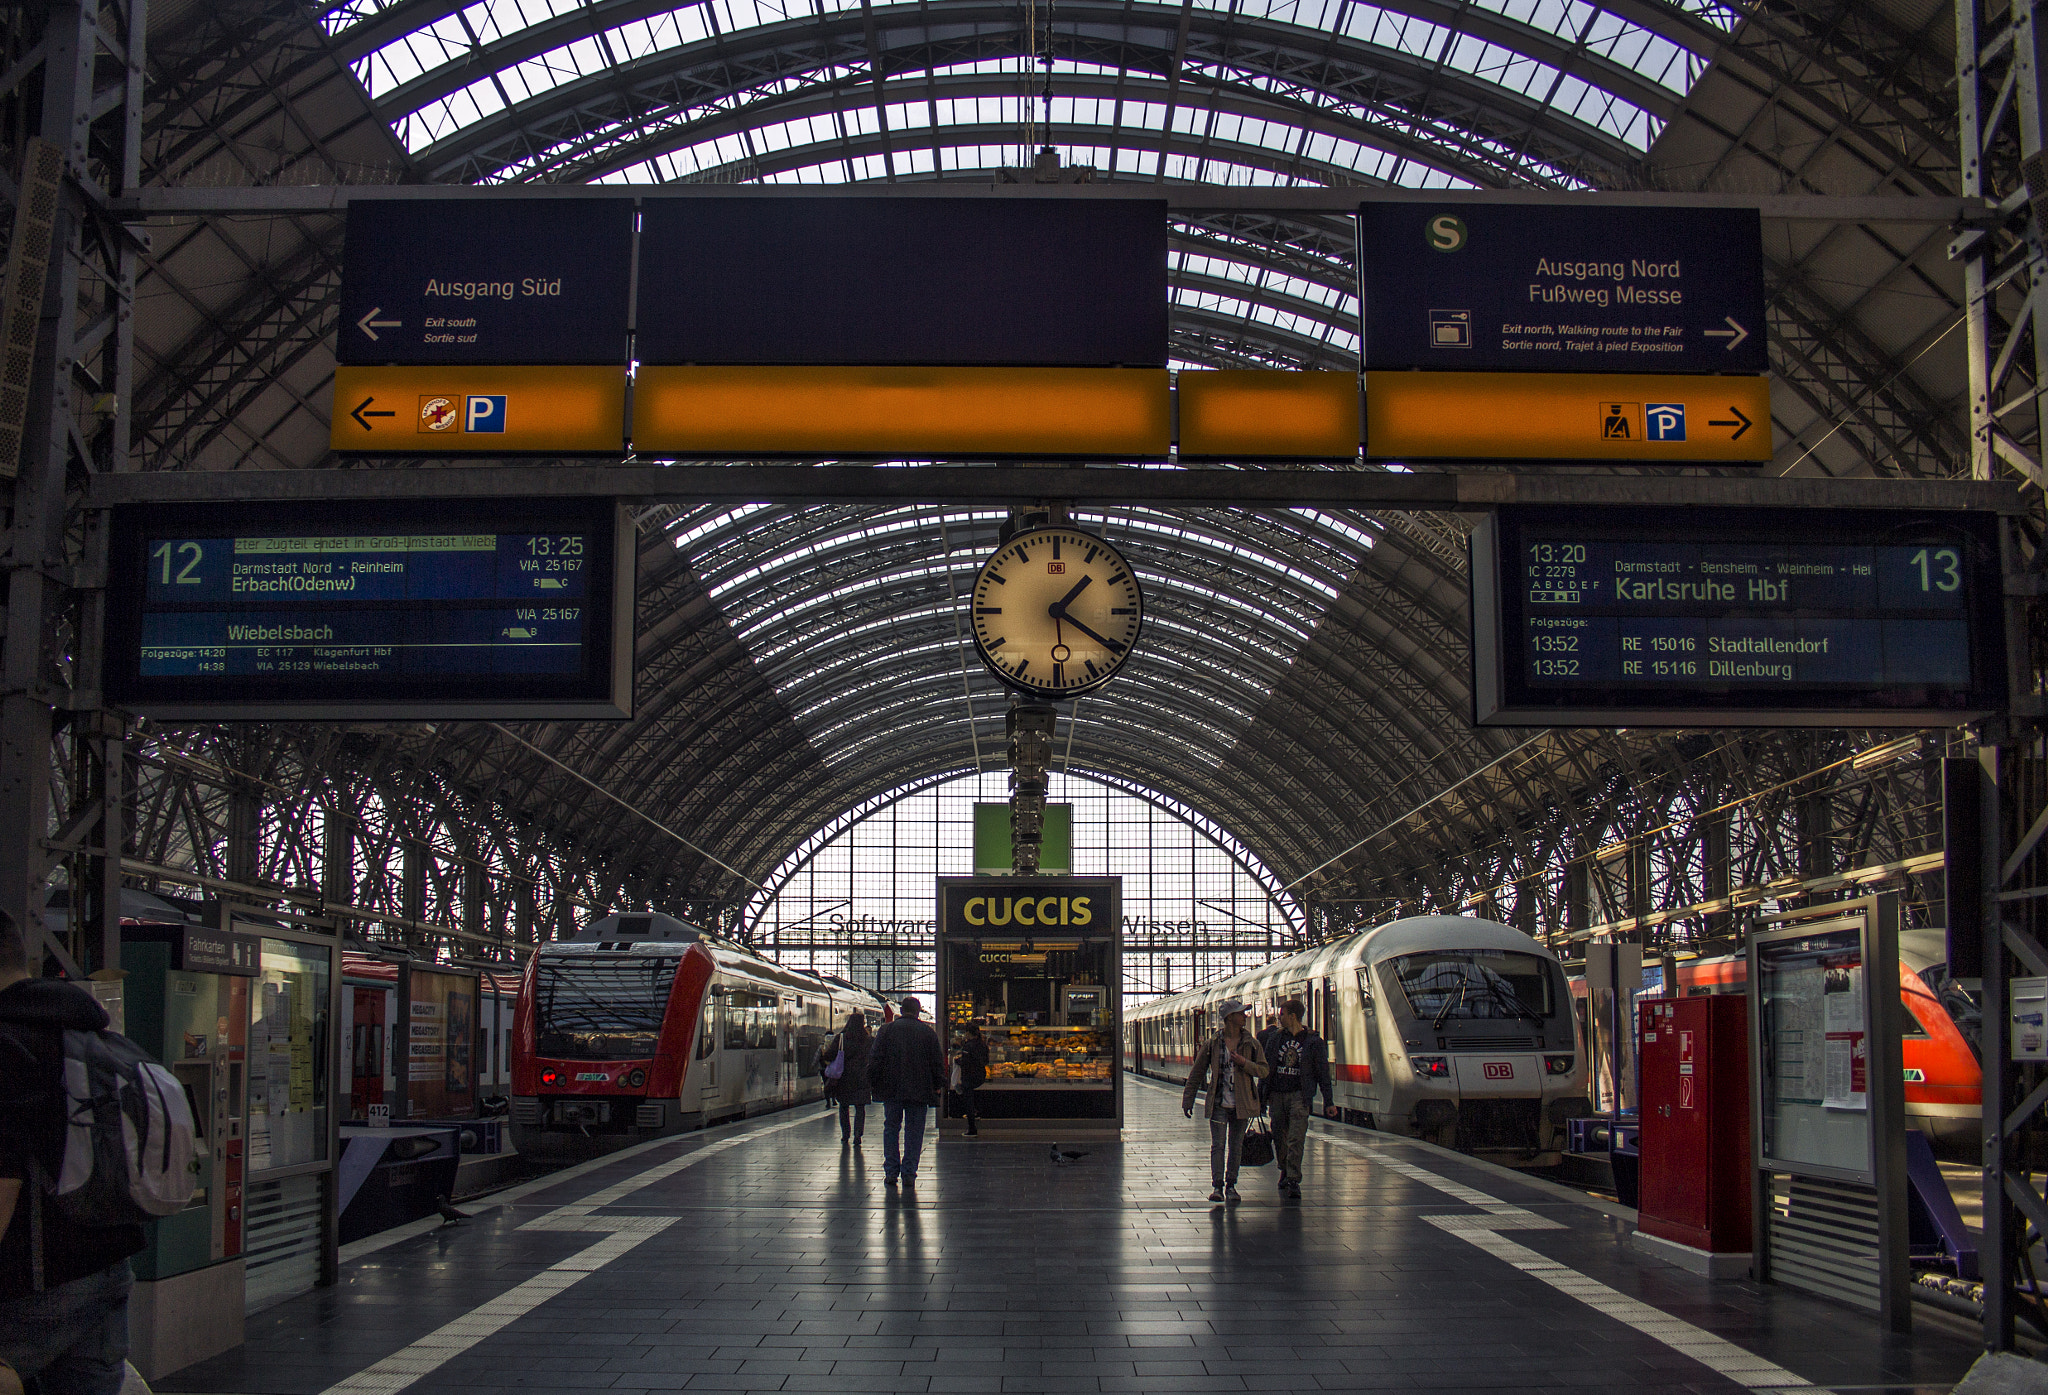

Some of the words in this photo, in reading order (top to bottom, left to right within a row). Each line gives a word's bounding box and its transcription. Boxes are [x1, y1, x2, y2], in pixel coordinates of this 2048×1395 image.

[1432, 217, 1460, 250] S
[1536, 258, 1624, 281] Ausgang
[1632, 260, 1680, 278] Nord
[425, 278, 514, 300] Ausgang
[521, 278, 561, 296] Süd
[1530, 285, 1608, 307] Fußweg
[1617, 287, 1682, 304] Messe
[425, 317, 445, 327] Exit
[447, 317, 477, 328] south
[1502, 324, 1522, 334] Exit
[1524, 325, 1555, 336] north,
[1557, 325, 1599, 337] Walking
[1601, 326, 1628, 336] route
[1631, 326, 1642, 336] to
[1644, 325, 1660, 336] the
[1663, 326, 1683, 336] Fair
[424, 333, 456, 343] Sortie
[457, 332, 477, 343] sud
[1502, 339, 1531, 351] Sortie
[1534, 340, 1563, 352] nord,
[1565, 341, 1593, 353] Trajet
[1597, 341, 1602, 351] à
[1606, 341, 1628, 353] pied
[1630, 341, 1683, 354] Exposition
[468, 397, 494, 431] P
[1658, 414, 1676, 439] P
[265, 538, 308, 551] Zugteil
[313, 537, 350, 549] endet
[354, 537, 366, 549] in
[526, 537, 583, 556] 13:25
[1529, 545, 1585, 563] 13:20
[153, 541, 203, 584] 12
[233, 562, 297, 574] Darmstadt
[303, 562, 332, 573] Nord
[351, 561, 403, 573] Reinheim
[519, 560, 541, 571] VIA
[546, 559, 583, 570] 25167
[1615, 561, 1680, 573] Darmstadt
[1701, 562, 1757, 574] Bensheim
[1777, 562, 1833, 575] Weinheim
[1852, 563, 1871, 575] Hei
[1909, 548, 1960, 592] 13
[1529, 566, 1542, 577] IC
[1545, 566, 1575, 577] 2279
[232, 576, 356, 592] Erbach(Odenw)
[1532, 581, 1540, 589] A
[1546, 581, 1551, 589] B
[1557, 581, 1564, 589] C
[1570, 581, 1576, 589] D
[1582, 581, 1588, 589] E
[1594, 581, 1599, 589] F
[1616, 577, 1735, 601] Karlsruhe
[1749, 578, 1790, 601] Hbf
[516, 609, 538, 620] VIA
[543, 608, 580, 620] 25167
[1530, 617, 1588, 628] Folgezüge:
[228, 624, 333, 640] Wiebelsbach
[141, 648, 197, 660] Folgezüge:
[199, 648, 226, 658] 14:20
[257, 648, 270, 657] EC
[275, 647, 293, 657] 117
[313, 646, 370, 659] Klagenfurt
[374, 646, 392, 657] Hbf
[1532, 636, 1579, 652] 13:52
[1623, 638, 1642, 651] RE
[1651, 638, 1696, 651] 15016
[1708, 637, 1829, 654] Stadtallendorf
[197, 662, 225, 671] 14:38
[257, 662, 274, 671] VIA
[278, 661, 310, 671] 25129
[314, 660, 379, 670] Wiebelsbach
[1533, 659, 1580, 675] 13:52
[1623, 662, 1643, 675] RE
[1651, 662, 1696, 675] 15116
[1709, 661, 1792, 680] Dillenburg
[963, 896, 1092, 926] CUCCIS
[828, 913, 936, 935] Software
[188, 936, 225, 954] Fahrkarten
[1486, 1065, 1511, 1077] DB
[369, 1105, 388, 1117] 412
